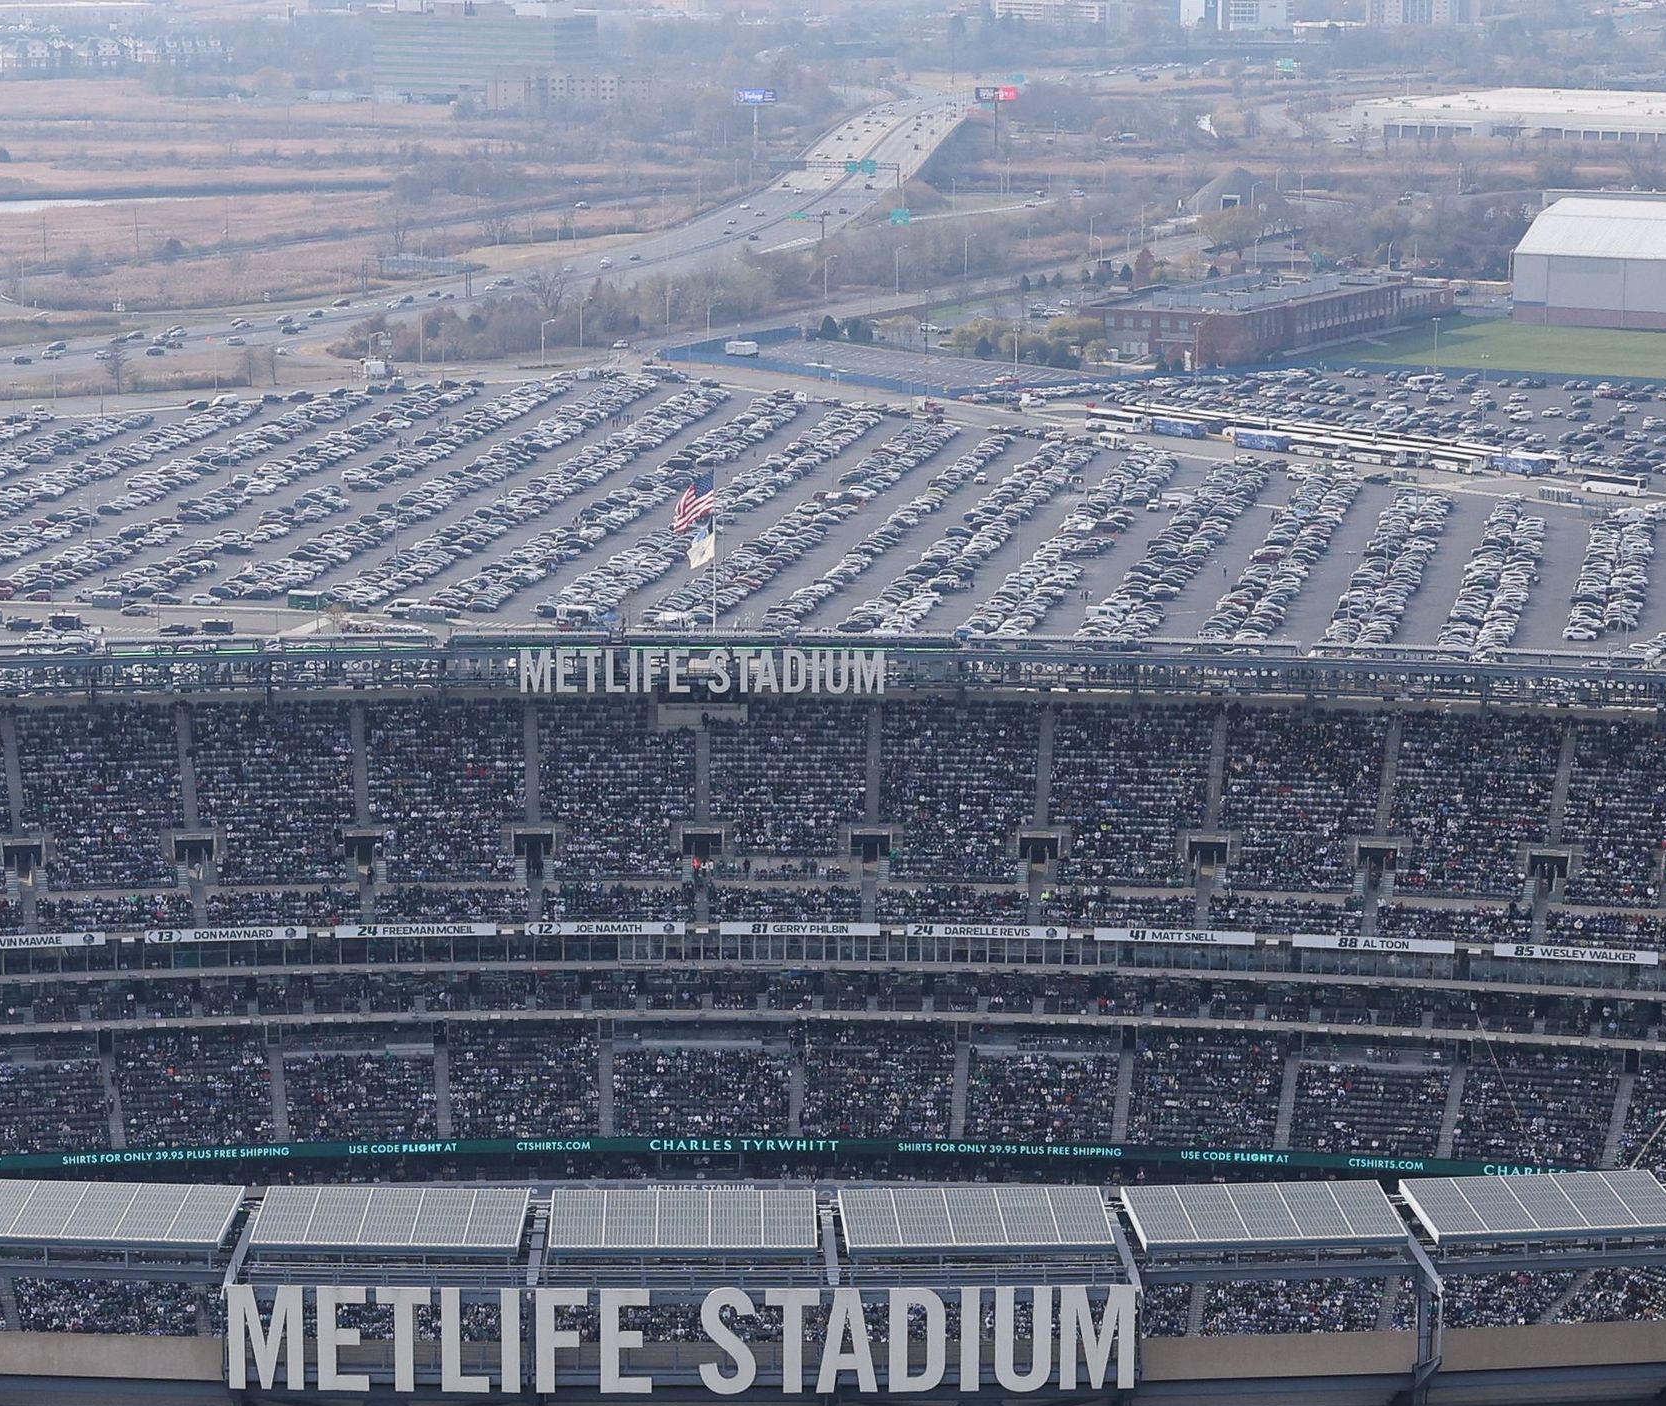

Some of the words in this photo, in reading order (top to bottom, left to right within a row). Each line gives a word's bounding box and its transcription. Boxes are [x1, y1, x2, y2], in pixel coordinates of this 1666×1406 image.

[519, 648, 692, 695] METLIFE
[706, 648, 885, 695] STADIUM
[156, 930, 174, 941] 13
[193, 929, 215, 940] DON
[216, 928, 273, 939] MAYNARD
[356, 926, 378, 936] 24
[382, 926, 432, 936] FREEMAN
[434, 925, 475, 935] MCNEIL
[537, 924, 552, 933] 12
[574, 925, 593, 933] JOE
[596, 925, 642, 933] NAMATH
[751, 924, 767, 933] 81
[773, 924, 808, 933] GERRY
[809, 925, 849, 934] PHILBIN
[913, 925, 934, 936] 24
[944, 926, 999, 936] DARRELLE
[1000, 927, 1030, 937] REVIS
[19, 936, 63, 947] MAWAE
[1129, 930, 1146, 940] 41
[1151, 931, 1183, 941] MATT
[1185, 932, 1217, 942] SNELL
[1338, 937, 1358, 948] 88
[1363, 939, 1378, 948] AL
[1379, 939, 1410, 949] TOON
[1514, 945, 1535, 956] 85
[1540, 948, 1587, 960] WESLEY
[1589, 950, 1636, 962] WALKER
[349, 1145, 368, 1154] USE
[371, 1144, 400, 1153] CODE
[402, 1143, 442, 1153] FLIGHT
[444, 1143, 457, 1152] AT
[516, 1141, 591, 1151] CTSHIRTS.COM
[649, 1139, 733, 1151] CHARLES
[741, 1140, 840, 1152] TYRWHITT
[898, 1143, 933, 1153] SHIRTS
[935, 1143, 956, 1153] FOR
[958, 1144, 988, 1154] ONLY
[989, 1144, 1018, 1154] 39.95
[1020, 1145, 1045, 1155] PLUS
[1047, 1146, 1071, 1156] FREE
[1072, 1147, 1123, 1157] SHIPPING
[62, 1154, 98, 1165] SHIRTS
[100, 1153, 121, 1163] FOR
[123, 1151, 154, 1162] ONLY
[155, 1150, 184, 1160] 39.95
[186, 1149, 212, 1160] PLUS
[214, 1148, 237, 1159] FREE
[239, 1146, 290, 1157] SHIPPING
[1181, 1151, 1201, 1160] USE
[1203, 1151, 1232, 1161] CODE
[1234, 1152, 1274, 1162] FLIGHT
[1276, 1154, 1289, 1163] AT
[1348, 1158, 1424, 1170] CTSHIRTS.COM
[225, 1284, 654, 1396] METLIFE
[697, 1284, 1137, 1398] STADIUM
